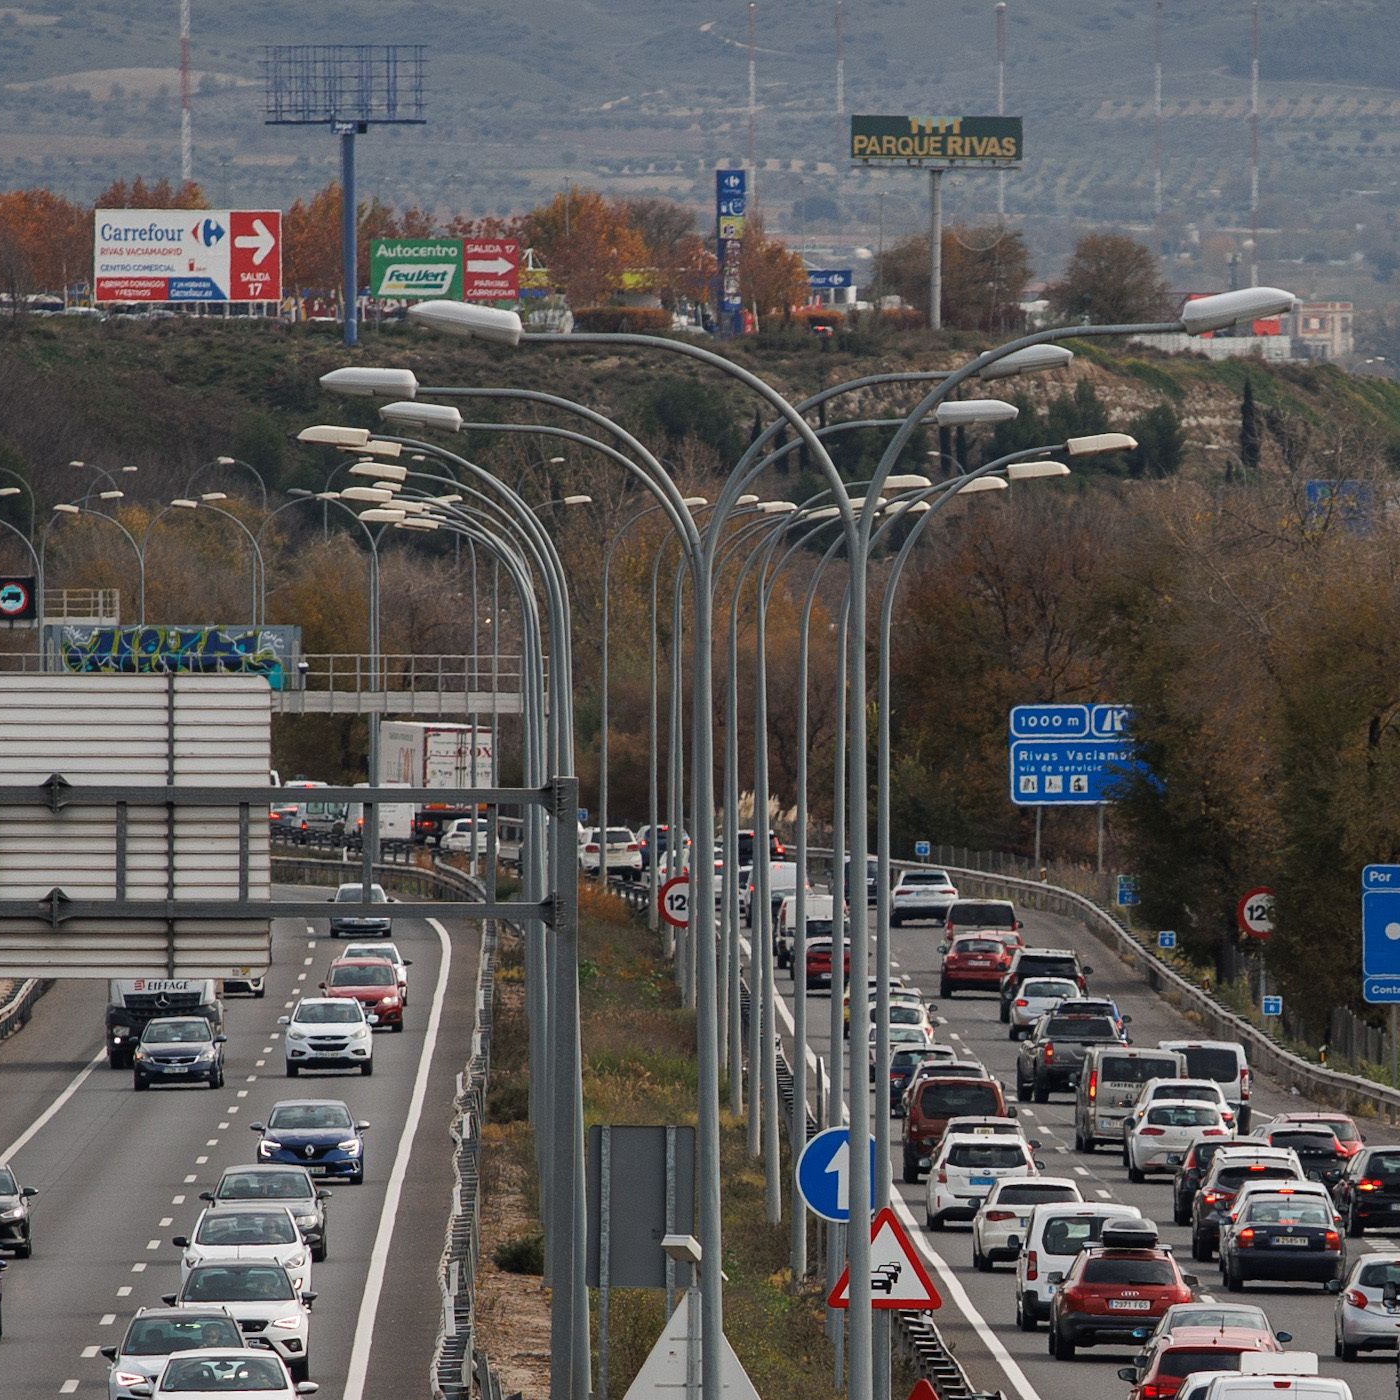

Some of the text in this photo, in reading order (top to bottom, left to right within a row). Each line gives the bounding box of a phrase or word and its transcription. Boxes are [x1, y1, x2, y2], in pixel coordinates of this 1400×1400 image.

[853, 135, 1017, 157] PARQUE RIVAS
[101, 223, 184, 242] Carrefour
[100, 247, 183, 256] RIVAS VACIAMADRID
[376, 243, 458, 258] Autocentro
[466, 244, 516, 254] SALIDA 17
[100, 264, 176, 273] CENTRO COMERCIAL
[240, 273, 271, 282] SALIDA
[473, 280, 509, 288] PARKING
[248, 283, 262, 297] 17
[466, 289, 516, 297] CARREFOUR
[1020, 716, 1080, 727] 1000 m
[1019, 750, 1059, 761] Rivas
[1369, 870, 1392, 882] Por
[147, 980, 190, 991] EIFFAGE
